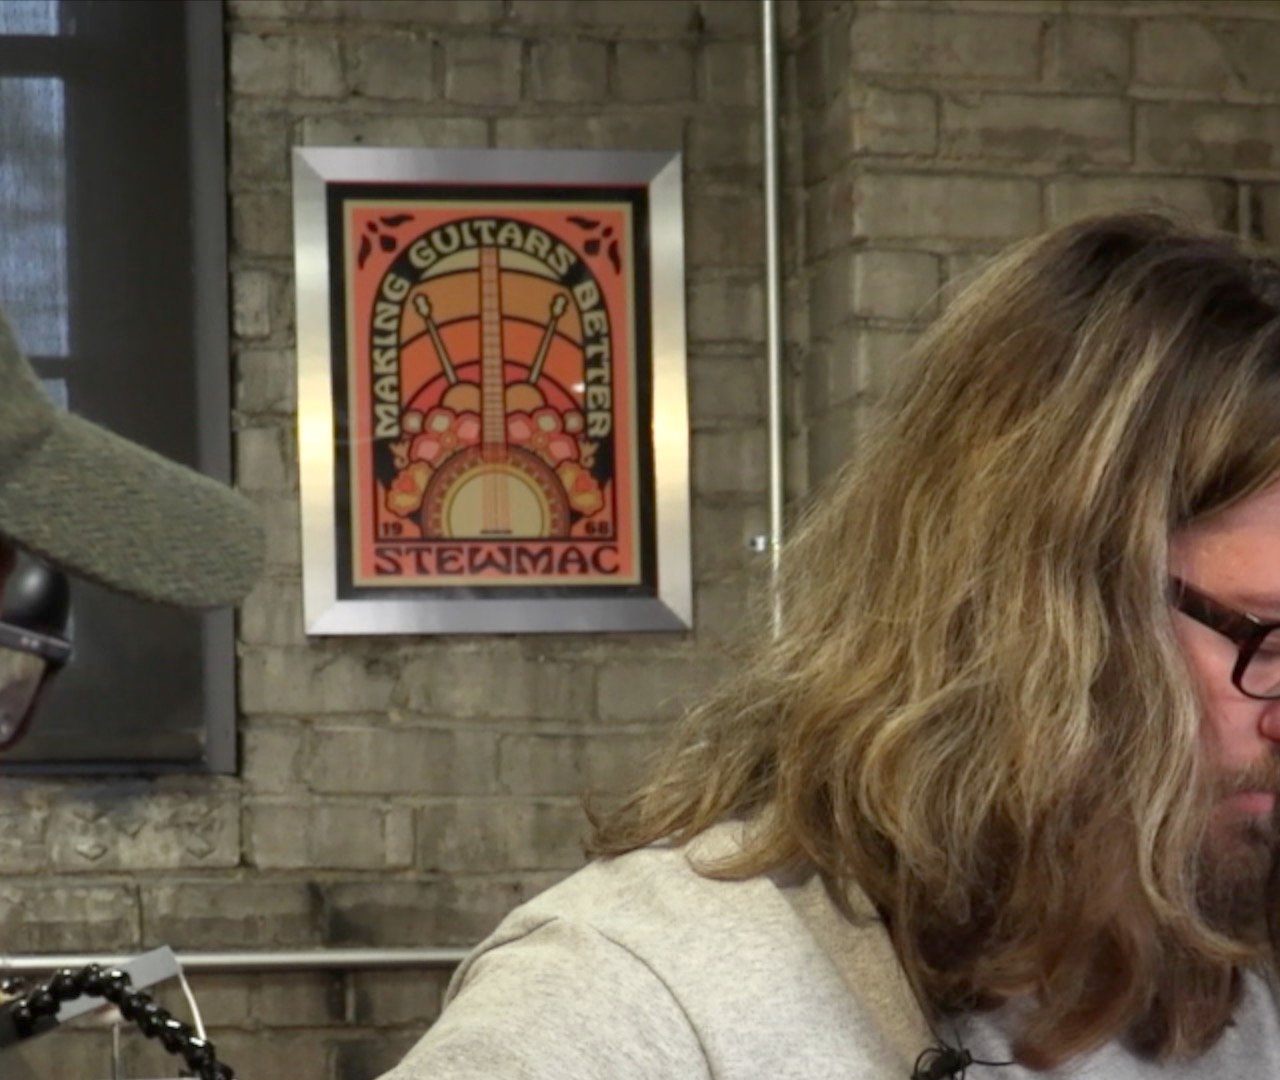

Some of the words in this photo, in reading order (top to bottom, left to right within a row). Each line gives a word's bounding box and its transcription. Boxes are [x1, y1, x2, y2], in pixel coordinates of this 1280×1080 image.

[372, 273, 410, 438] MAKING
[408, 220, 575, 275] GUITARS
[573, 279, 612, 438] BETTER
[381, 521, 403, 536] 19
[373, 546, 620, 576] STEWMAC
